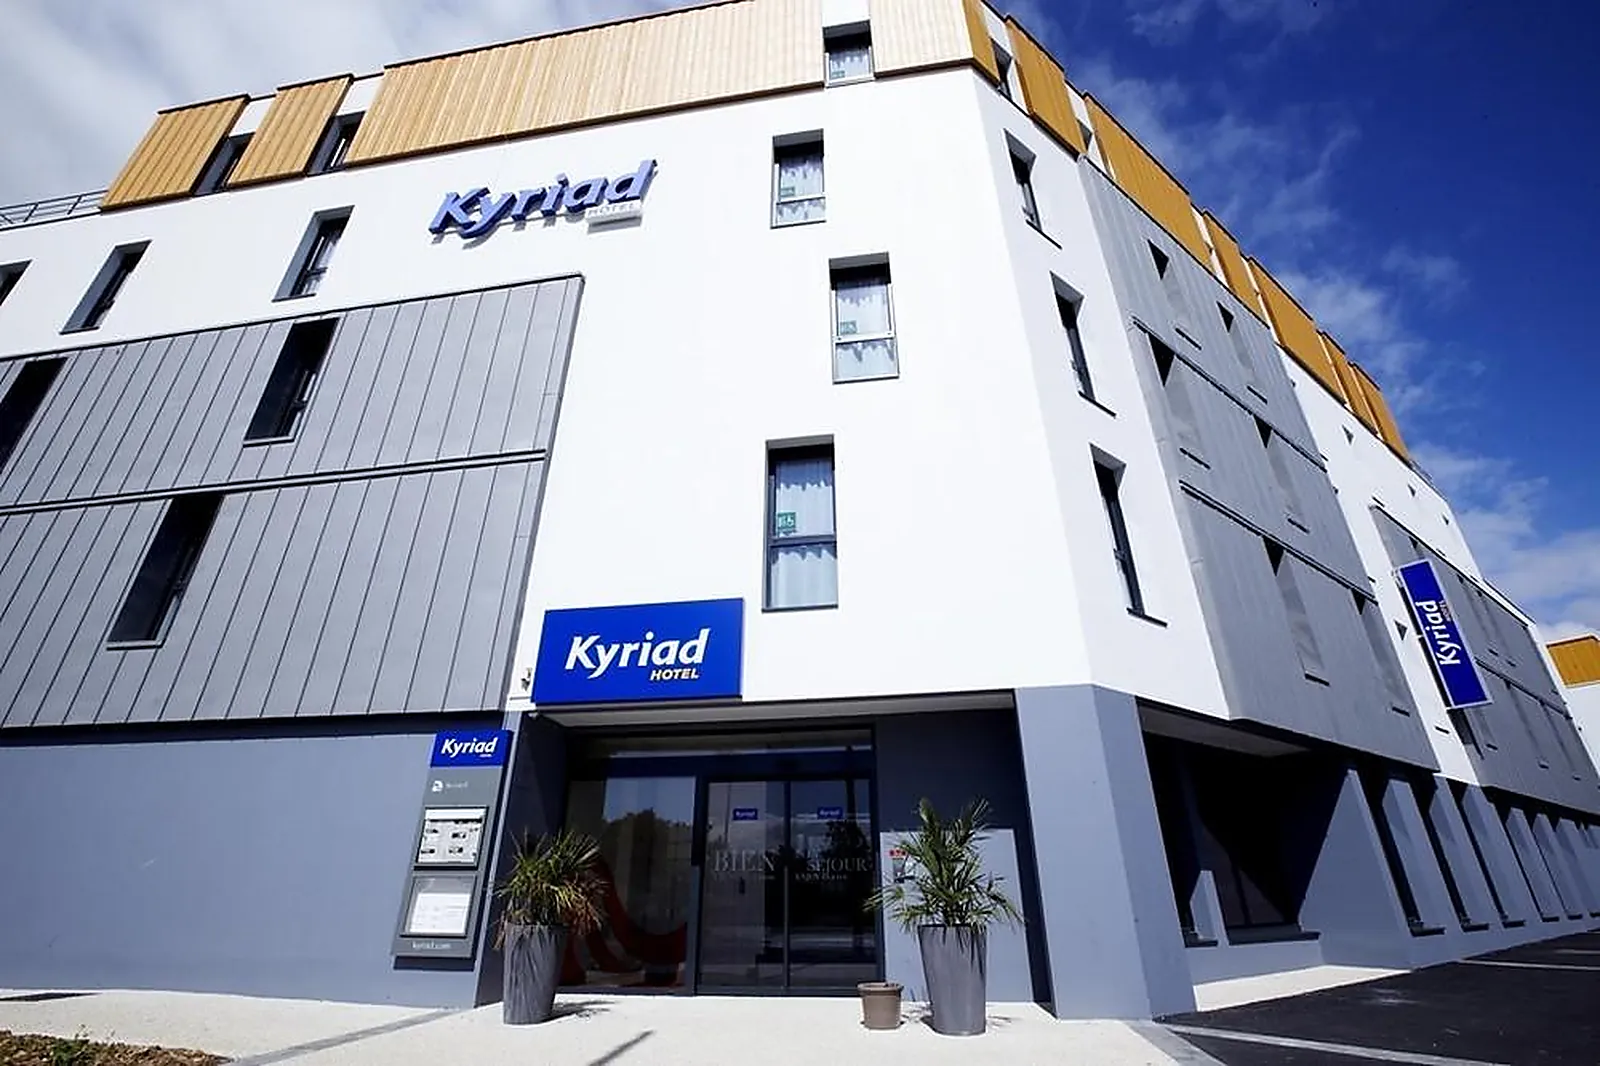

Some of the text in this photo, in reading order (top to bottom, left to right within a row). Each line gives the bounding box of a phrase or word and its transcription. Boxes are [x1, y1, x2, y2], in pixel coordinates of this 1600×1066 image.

[428, 160, 657, 240] Kyriad
[1415, 600, 1461, 665] Kyriad
[565, 628, 711, 679] Kyriad
[650, 668, 699, 681] HOTEL
[441, 737, 498, 758] Kyriad
[714, 850, 776, 872] BIEN
